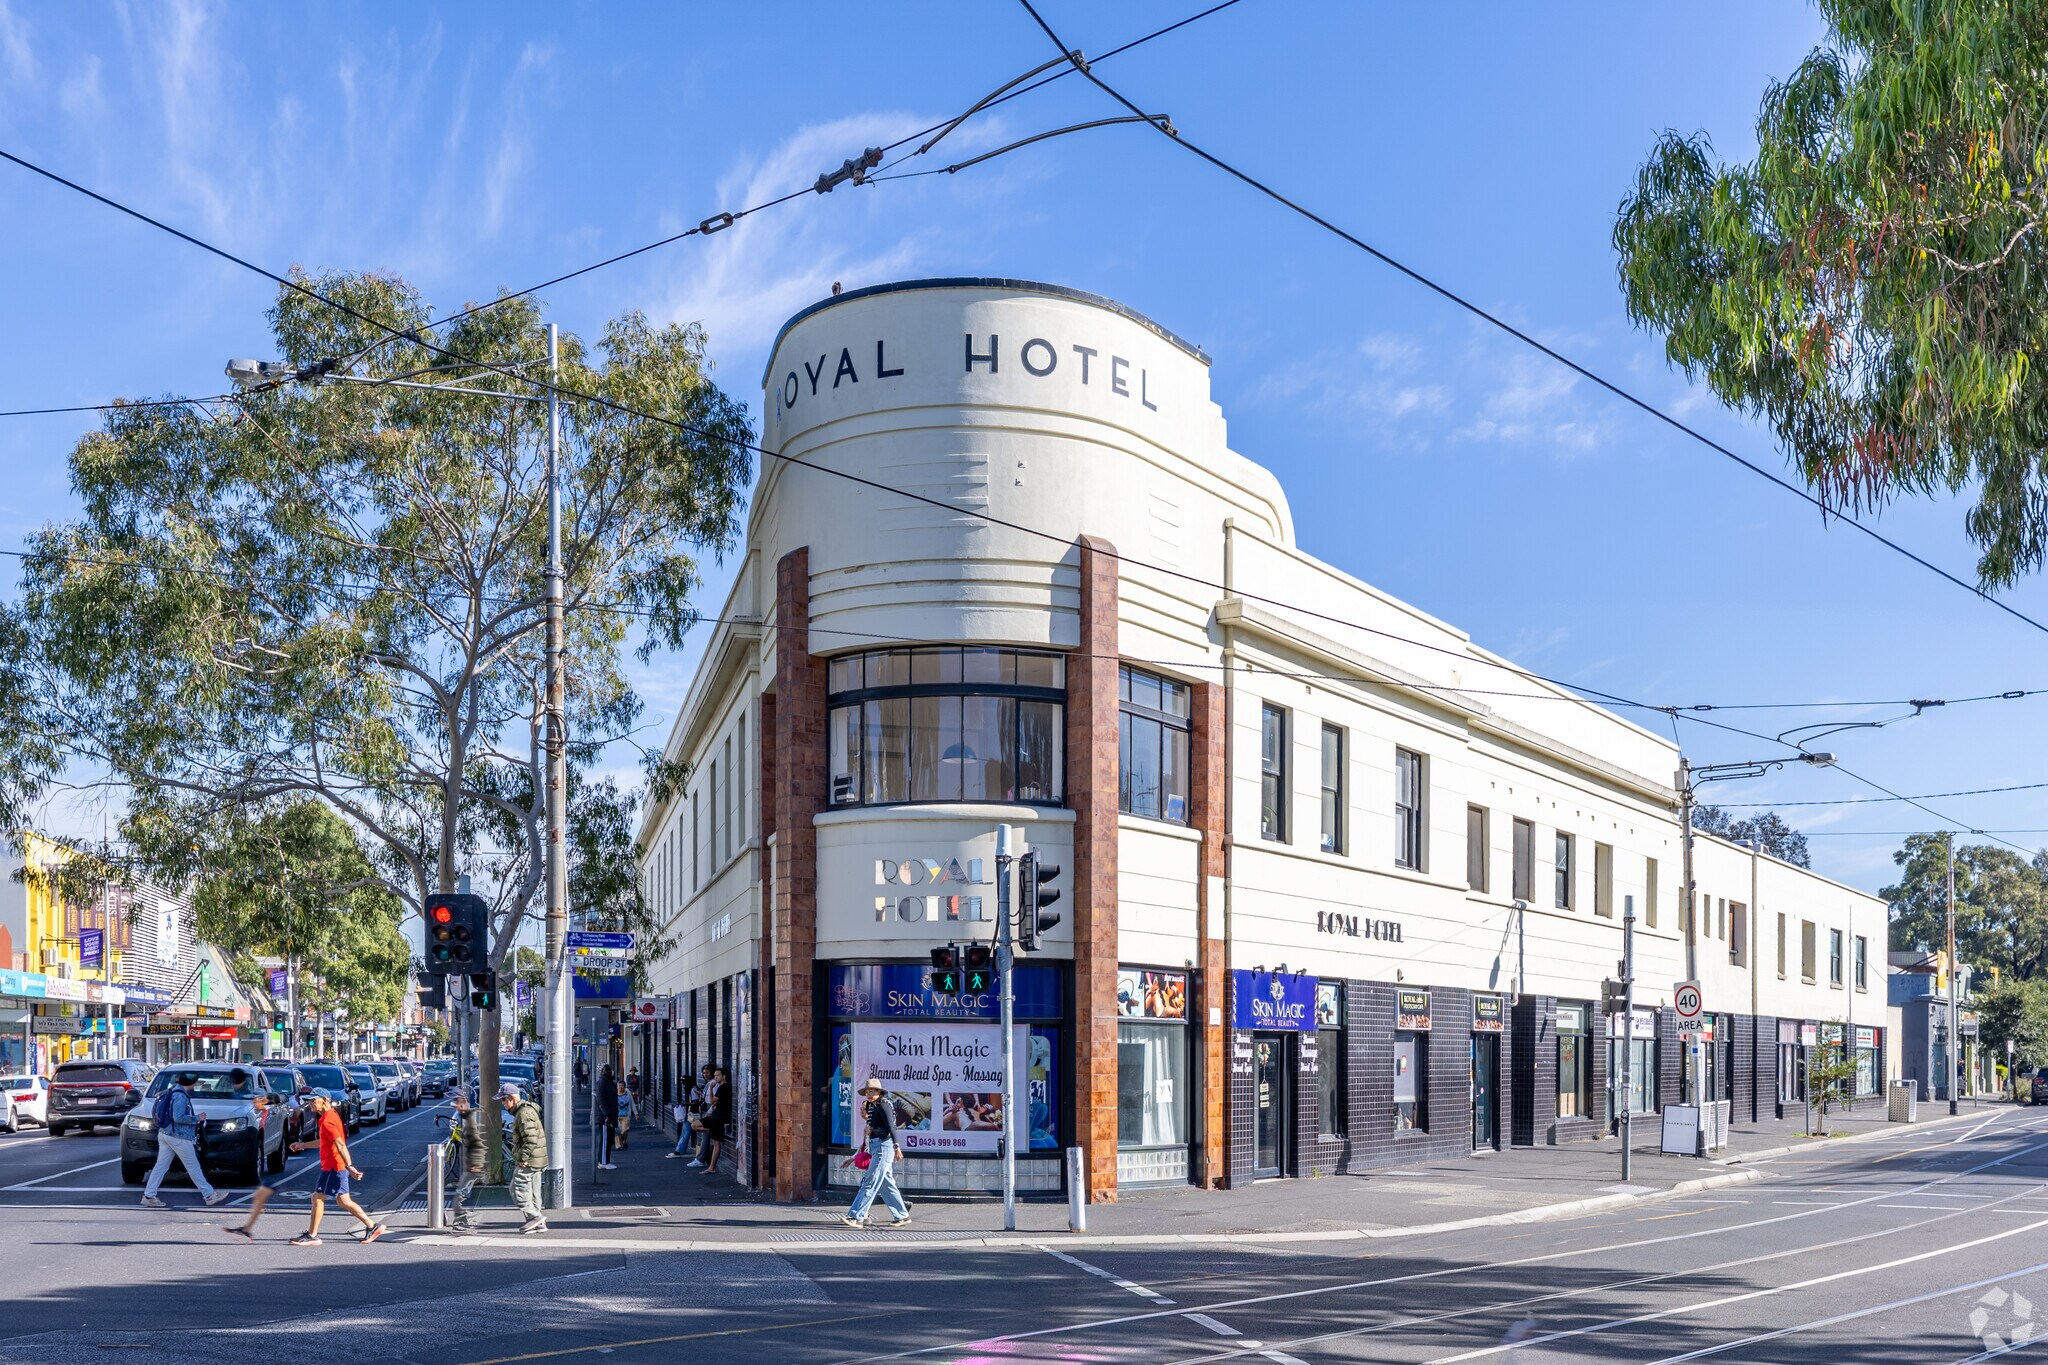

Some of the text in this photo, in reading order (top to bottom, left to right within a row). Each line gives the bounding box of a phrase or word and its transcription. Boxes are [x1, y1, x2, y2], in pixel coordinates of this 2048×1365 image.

[776, 333, 1157, 428] ROYAL HOTEL
[875, 857, 994, 922] ROYAL HOTEL
[1317, 910, 1404, 943] ROYAL HOTEL
[583, 957, 626, 968] DROOP ST
[887, 991, 924, 1007] SKIN
[930, 992, 989, 1008] MAGIC
[1253, 998, 1305, 1019] SKIN MAGIC
[1679, 994, 1697, 1008] 40
[1678, 1020, 1703, 1031] AREA
[886, 1035, 990, 1062] Skin Magic
[870, 1064, 900, 1080] Hanna
[903, 1064, 929, 1080] Head
[932, 1065, 952, 1086] Spa
[963, 1065, 1003, 1086] Massag
[919, 1138, 936, 1146] 0424
